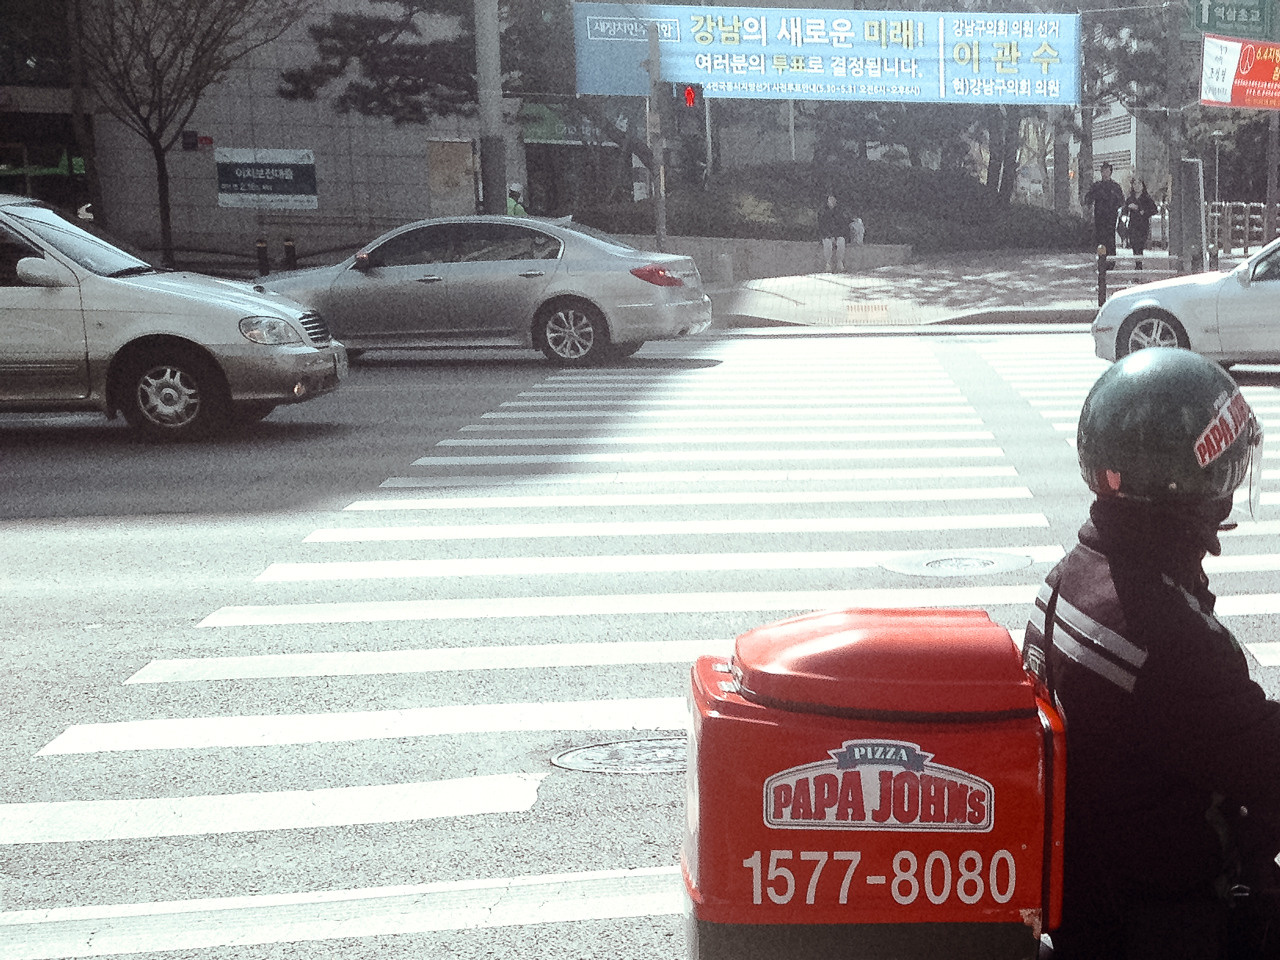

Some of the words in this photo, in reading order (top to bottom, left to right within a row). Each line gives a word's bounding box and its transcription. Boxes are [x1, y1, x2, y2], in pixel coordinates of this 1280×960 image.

[593, 21, 674, 38] 새정치민주합
[690, 14, 767, 47] 강남의
[776, 17, 856, 48] 새로운
[864, 19, 924, 50] 미래!
[952, 19, 1008, 37] 강남구의회
[1011, 20, 1035, 38] 의원
[1037, 20, 1060, 38] 선거
[695, 53, 766, 75] 여러분의
[771, 54, 826, 76] 투표로
[830, 56, 924, 79] 결정됩니다.
[1035, 79, 1060, 97] 의원
[1196, 416, 1235, 464] PAPA
[853, 746, 908, 762] PIZZA
[772, 770, 867, 822] PAPA
[871, 770, 987, 825] JOHN'S
[742, 849, 1017, 905] 1577-8080
